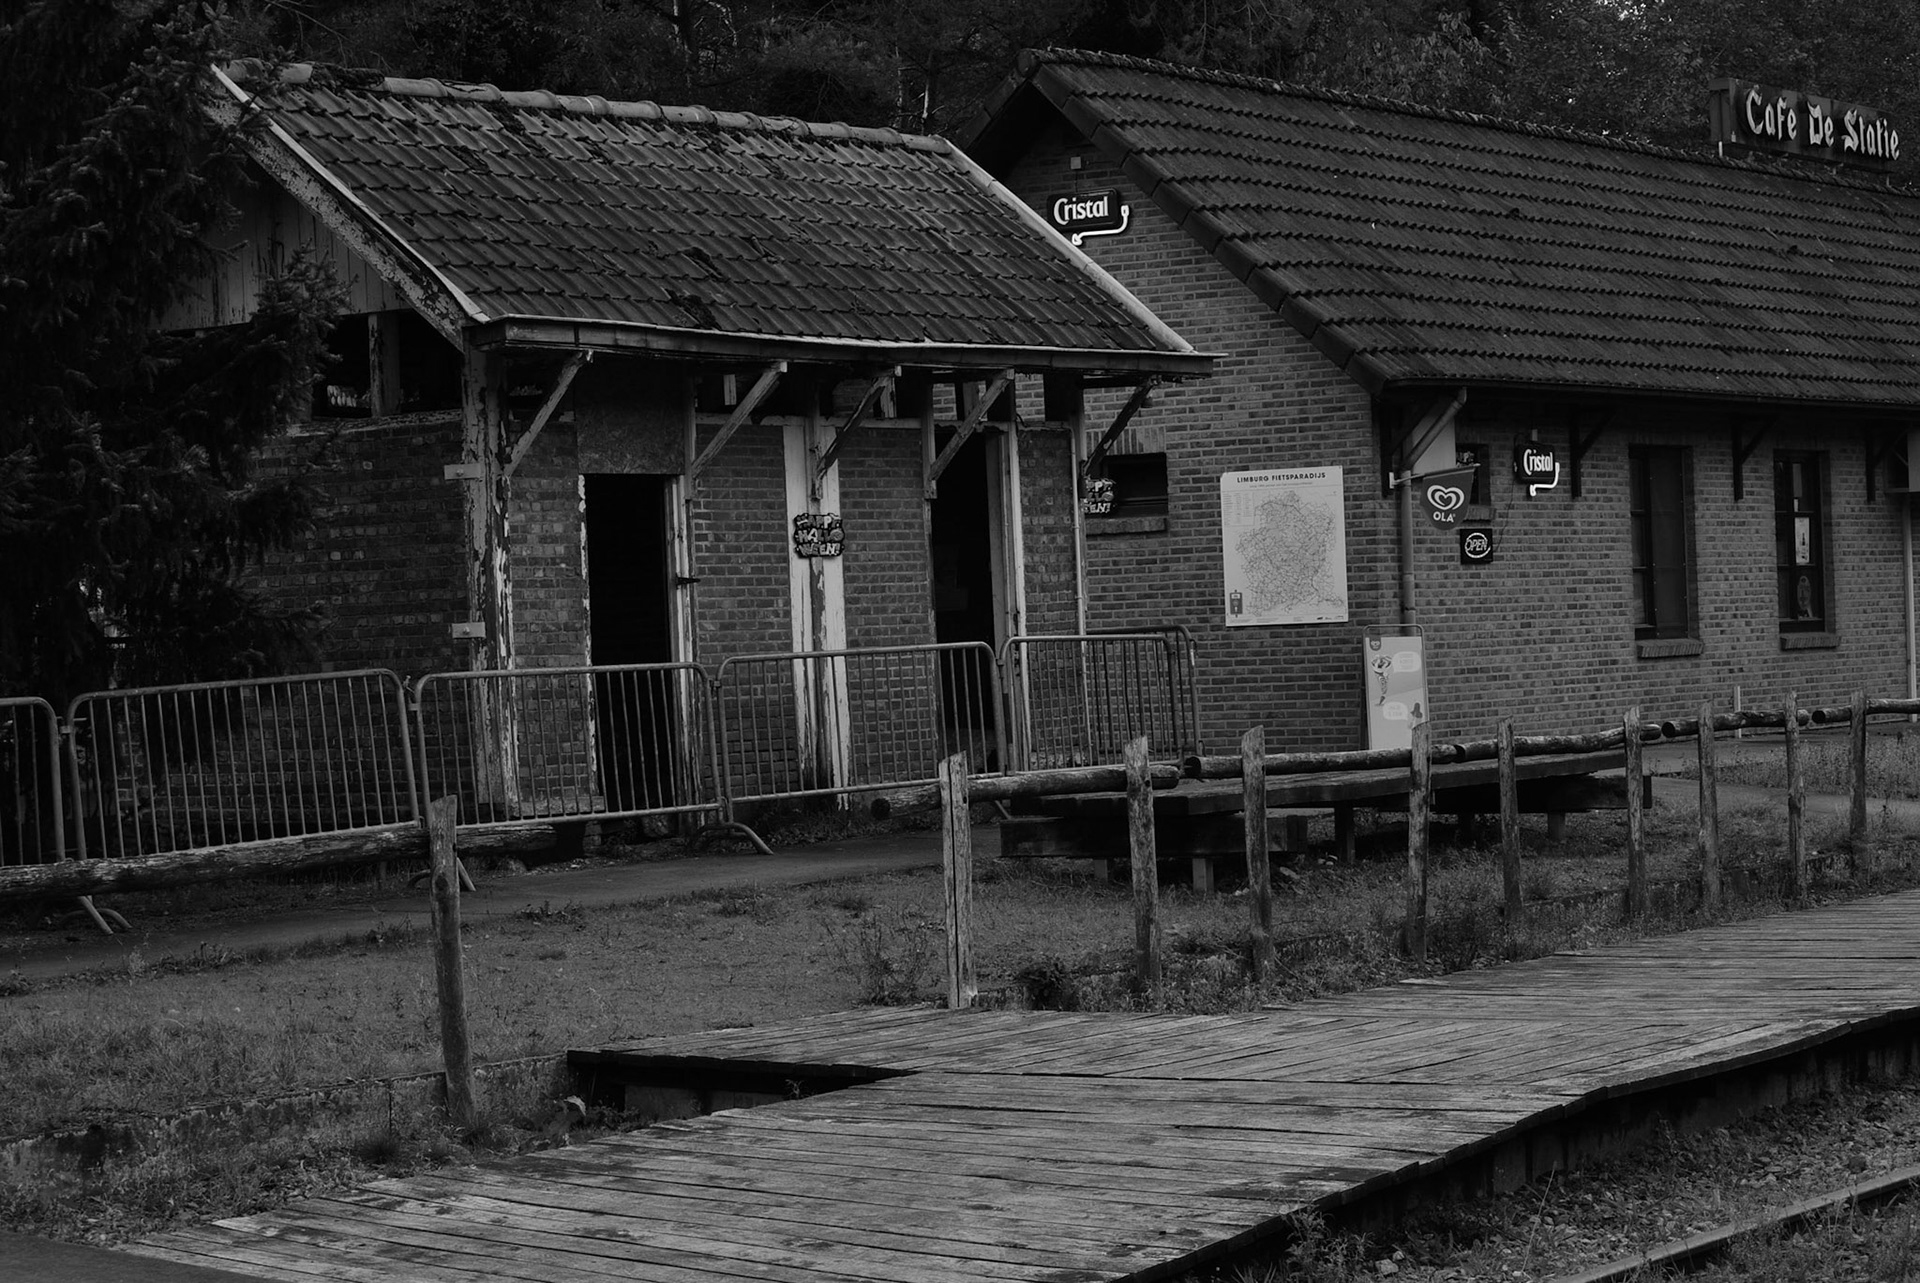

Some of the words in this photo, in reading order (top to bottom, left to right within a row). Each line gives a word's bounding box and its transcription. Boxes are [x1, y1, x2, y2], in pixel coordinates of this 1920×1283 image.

[1807, 101, 1835, 147] De
[1841, 108, 1900, 161] Statie
[1053, 196, 1109, 225] Cristal
[1523, 448, 1553, 476] Cristal
[1236, 475, 1269, 483] LIMBURG
[1271, 472, 1326, 481] FIETSPARADIJS
[1465, 538, 1488, 552] OPEN
